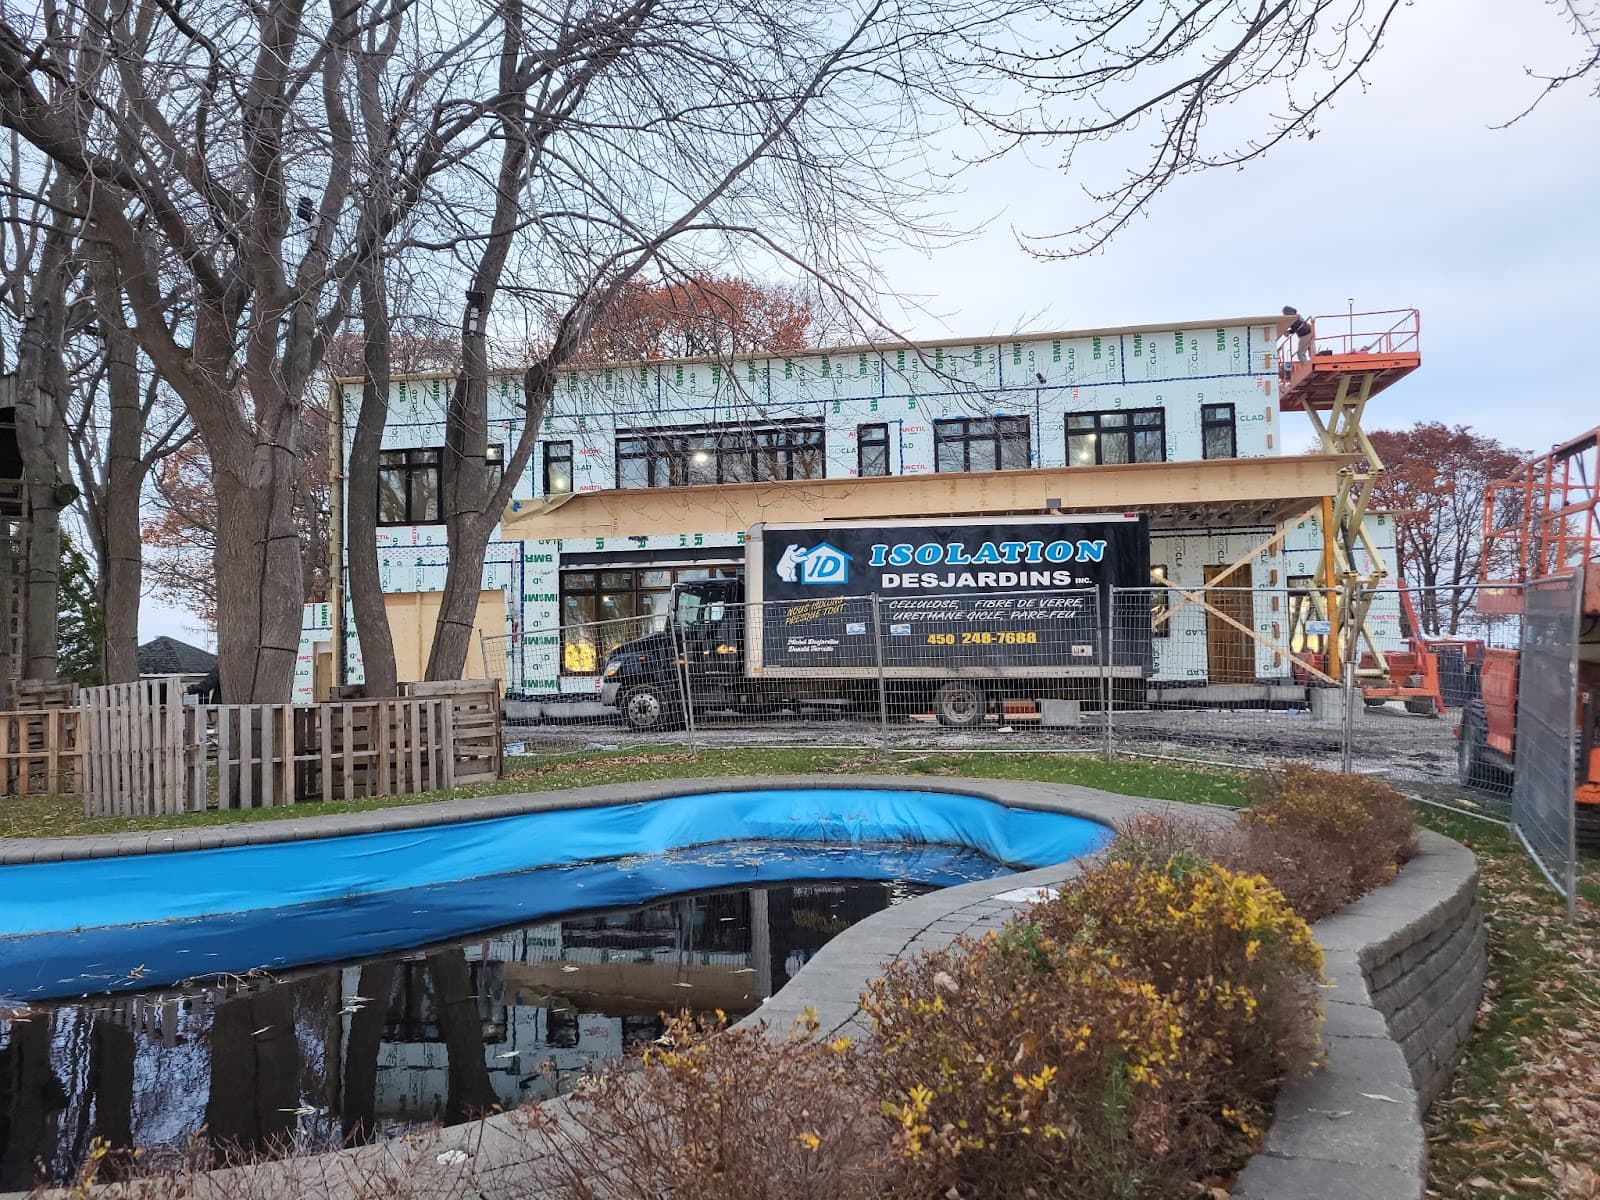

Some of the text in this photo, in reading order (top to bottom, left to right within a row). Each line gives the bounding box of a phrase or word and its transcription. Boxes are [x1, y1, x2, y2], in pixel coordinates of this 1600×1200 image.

[1239, 414, 1264, 422] CLAD
[868, 540, 1107, 566] ISOLATION
[808, 555, 841, 578] ID
[881, 571, 1071, 588] DESJARDINS
[889, 600, 959, 609] CELLULOSE,
[975, 599, 1013, 608] FIBRE
[1017, 599, 1037, 608] DE
[1010, 610, 1076, 619] PARE-FEU
[927, 633, 955, 645] 450
